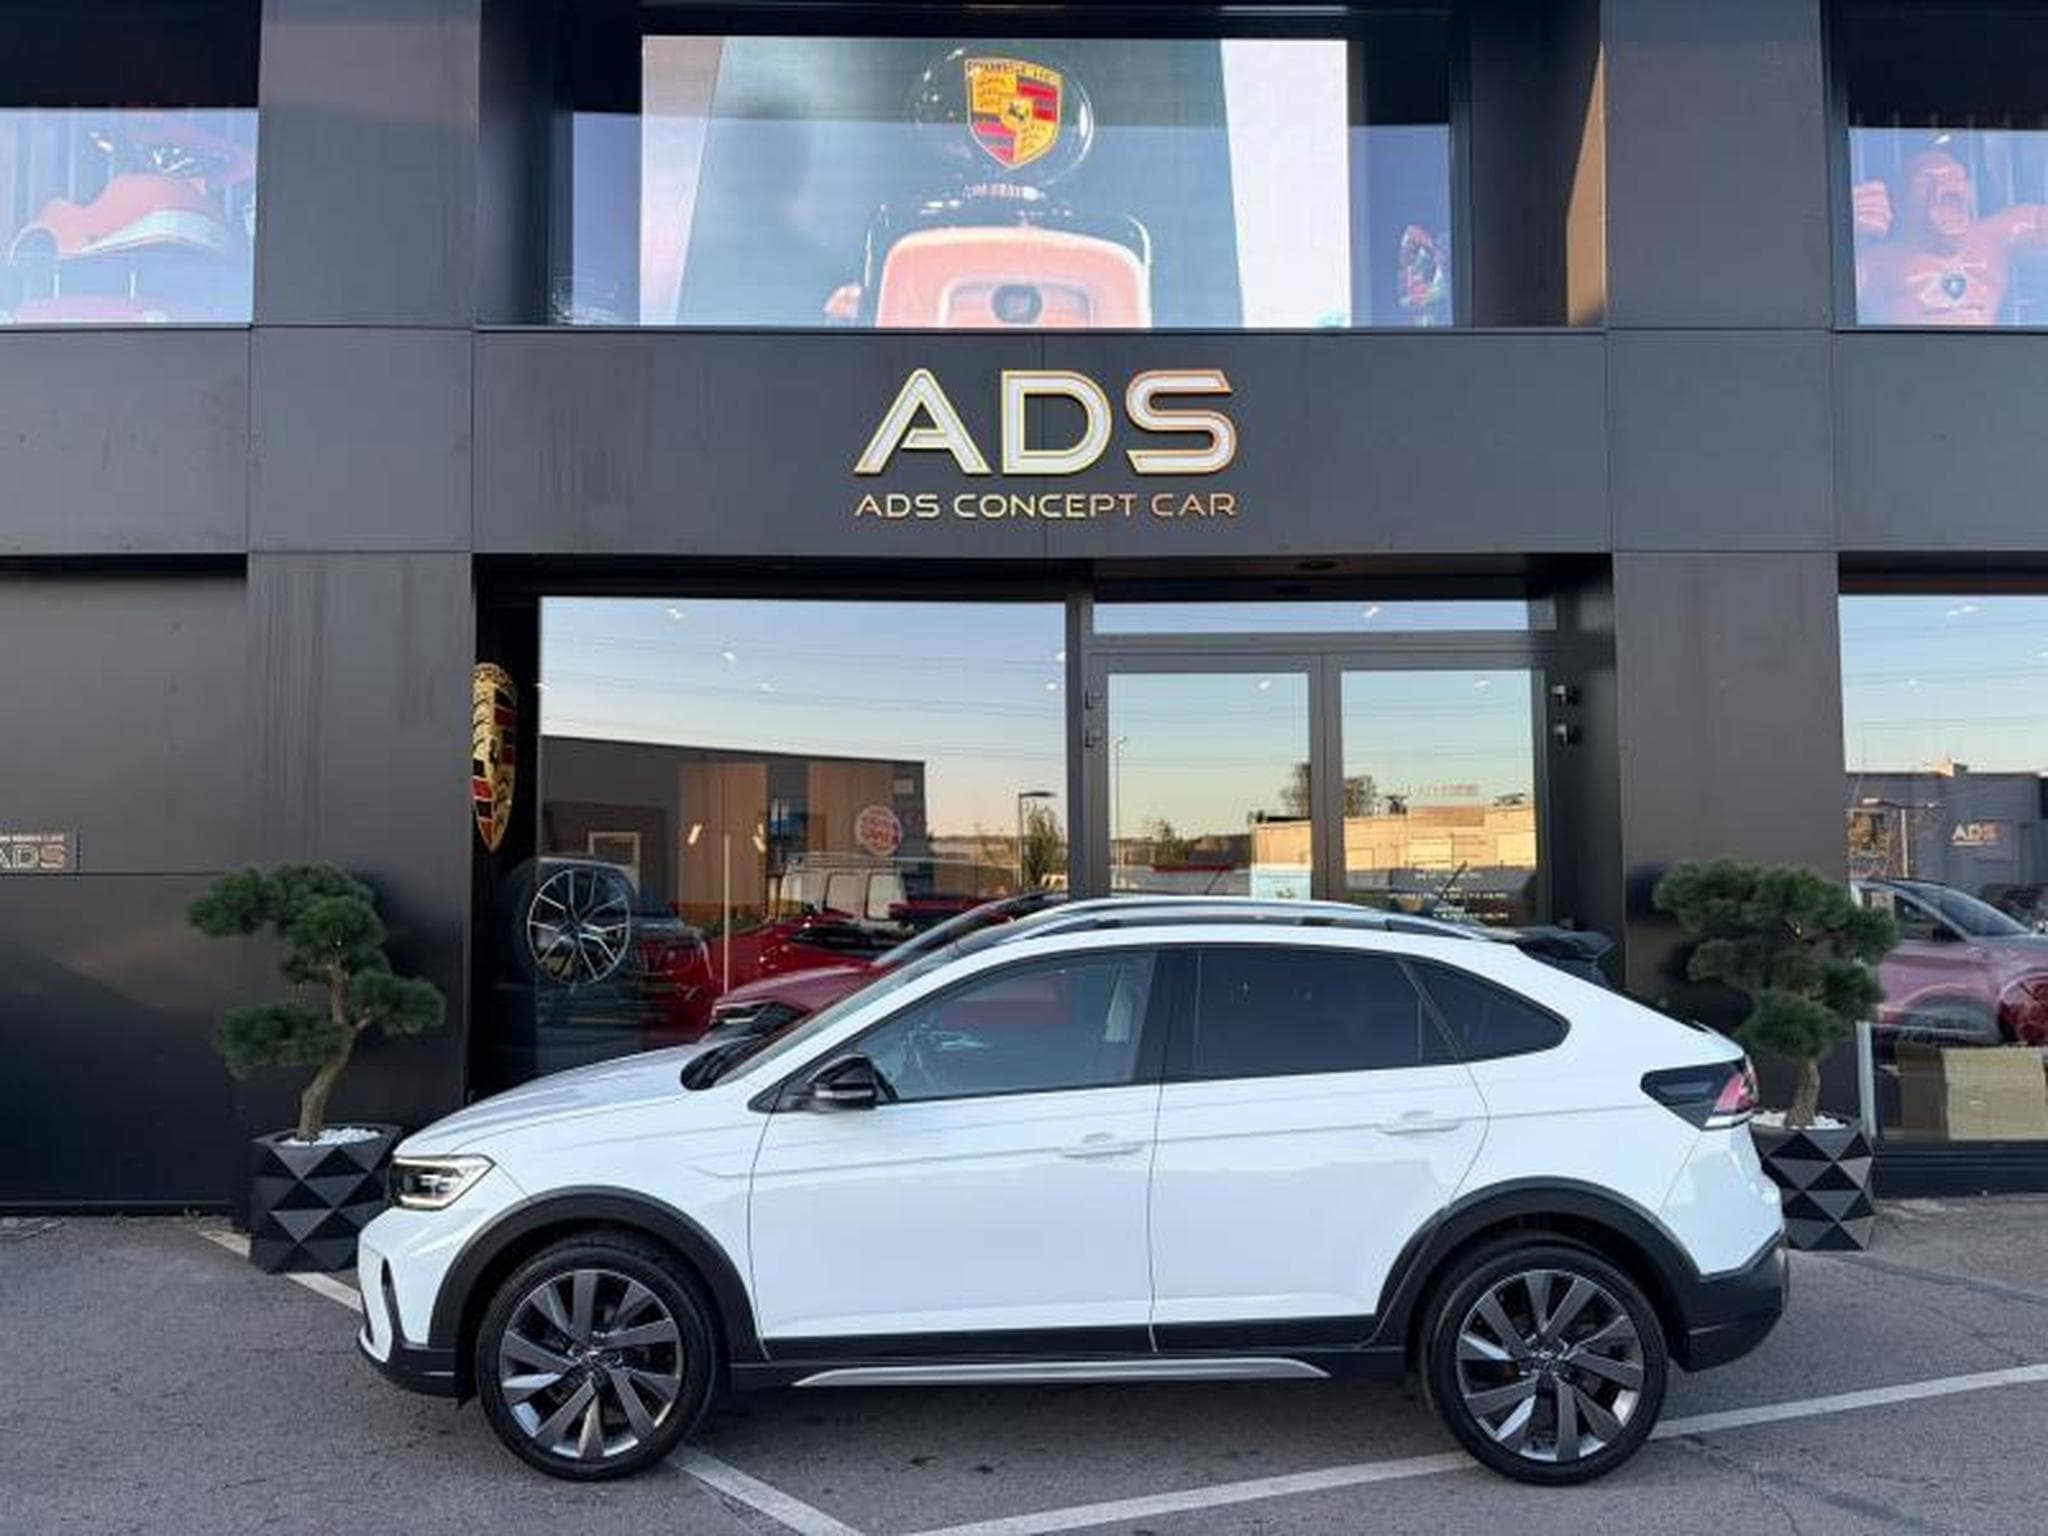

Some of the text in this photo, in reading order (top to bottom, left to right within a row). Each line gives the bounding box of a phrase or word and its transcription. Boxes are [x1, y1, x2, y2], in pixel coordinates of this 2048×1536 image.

[853, 367, 1238, 475] ADS
[854, 493, 1238, 518] ADS CONCEPT CAR
